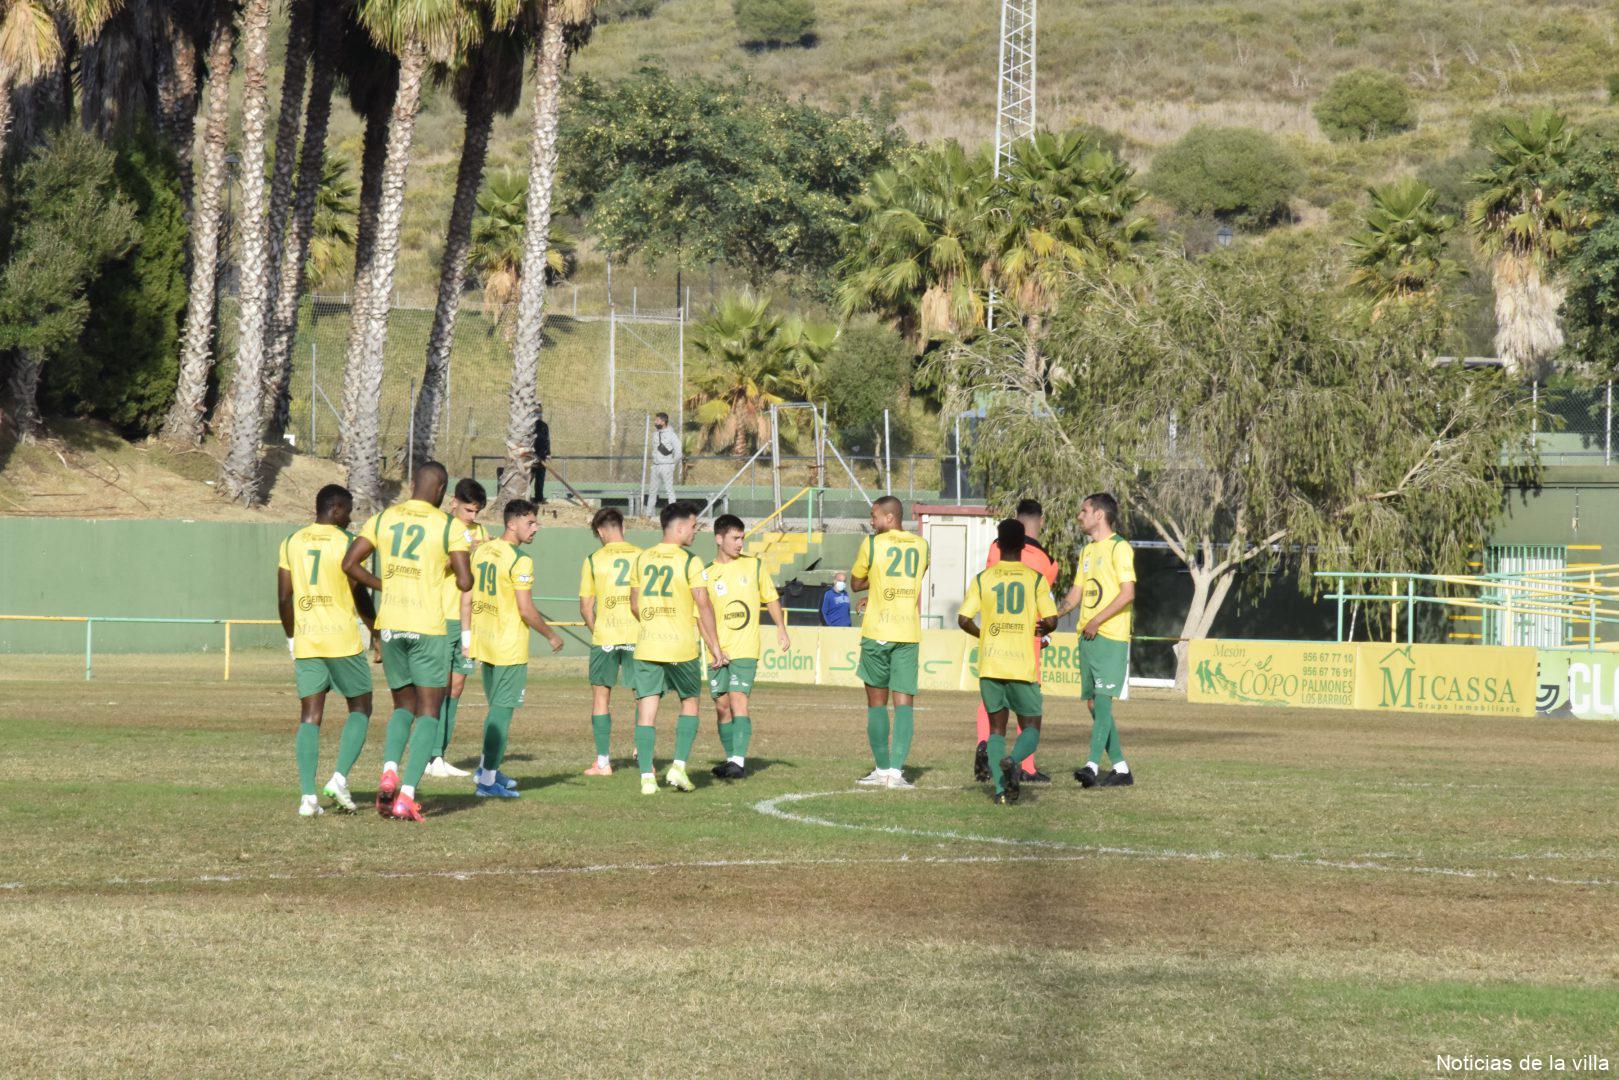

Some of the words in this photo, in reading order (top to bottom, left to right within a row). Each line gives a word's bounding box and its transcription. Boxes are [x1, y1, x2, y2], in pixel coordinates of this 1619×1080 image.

[390, 522, 425, 561] 12
[307, 550, 321, 585] 7
[613, 559, 630, 586] 2
[886, 546, 919, 578] 20
[477, 561, 497, 596] 19
[643, 564, 674, 597] 22
[991, 581, 1025, 615] 10
[763, 646, 814, 671] Galán
[1254, 655, 1273, 672] el
[1303, 652, 1317, 661] 956
[1319, 652, 1329, 662] 67
[1331, 653, 1341, 662] 77
[1344, 654, 1353, 663] 10
[1239, 669, 1298, 696] COPO
[1319, 667, 1328, 676] 67
[1302, 679, 1353, 694] PALMONES
[1302, 693, 1316, 704] LOS
[1317, 693, 1353, 705] BARRIOS
[1378, 666, 1516, 708] MICASSA
[1569, 662, 1619, 714] CL
[1418, 702, 1448, 711] Grupo
